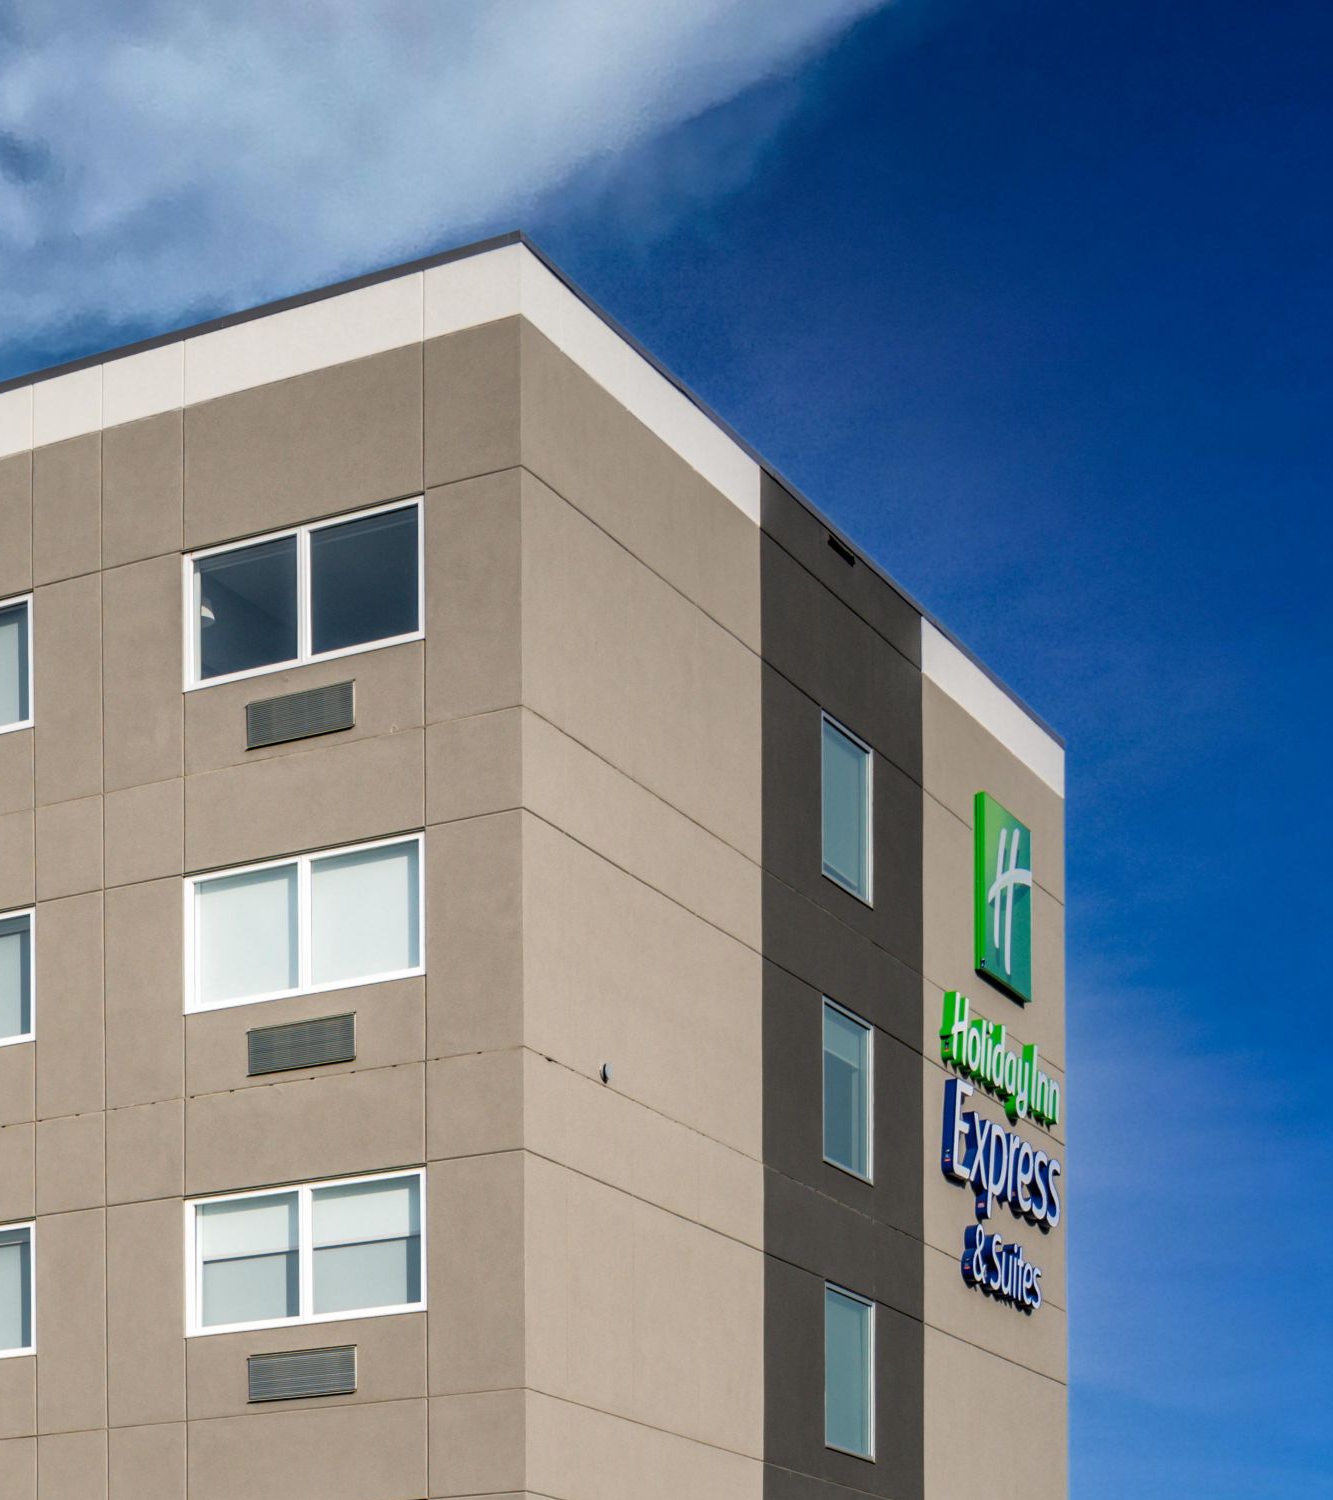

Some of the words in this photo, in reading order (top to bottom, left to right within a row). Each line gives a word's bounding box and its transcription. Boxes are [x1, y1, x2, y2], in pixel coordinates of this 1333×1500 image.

[942, 991, 1030, 1118] Holiday
[1027, 1044, 1060, 1124] Inn
[944, 1078, 1061, 1227] Express
[966, 1224, 987, 1284] &
[988, 1233, 1042, 1309] Suites
